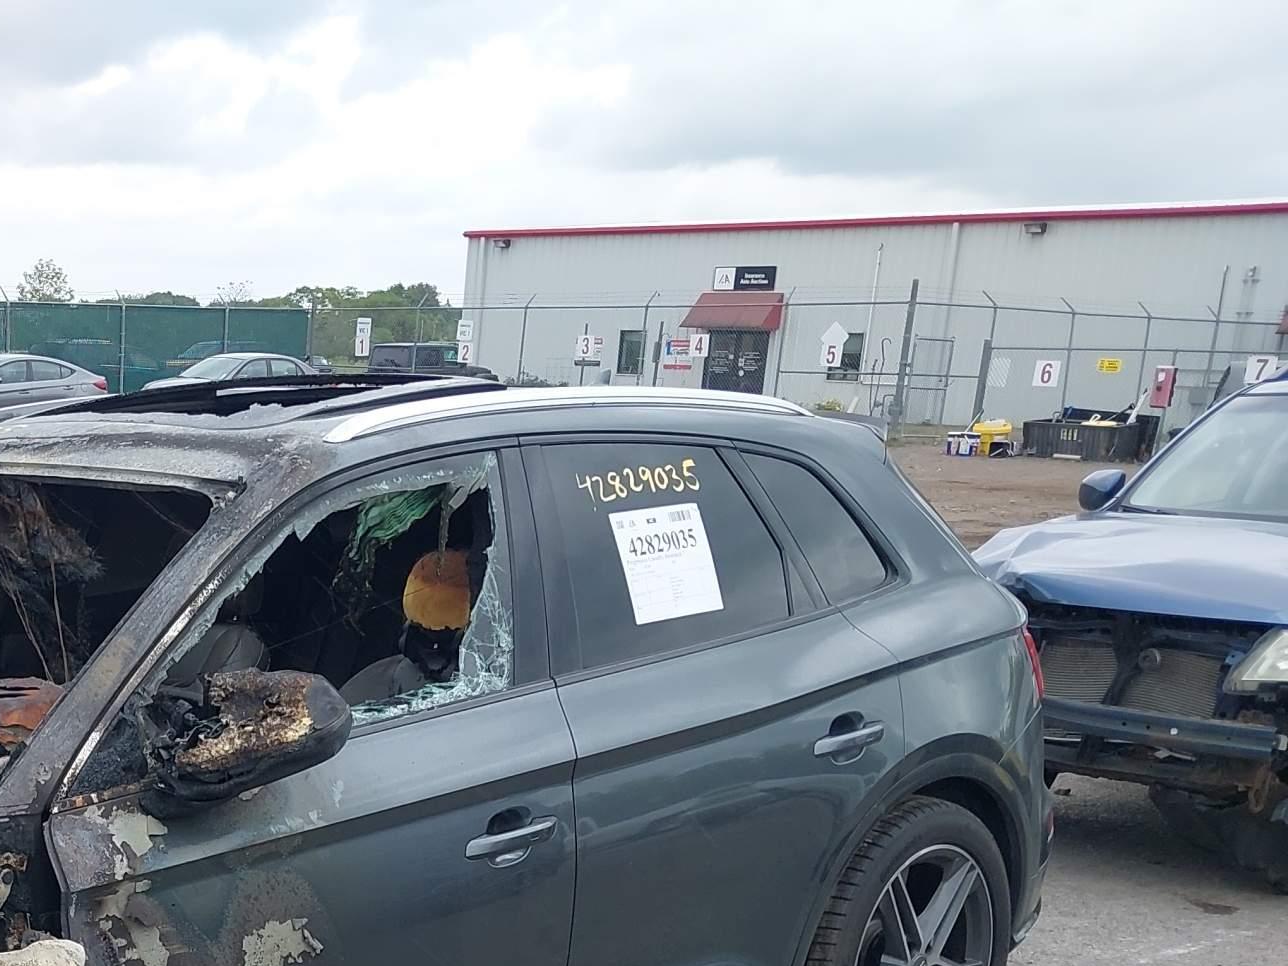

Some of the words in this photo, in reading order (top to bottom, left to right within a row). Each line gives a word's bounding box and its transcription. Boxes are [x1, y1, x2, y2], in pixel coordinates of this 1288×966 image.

[359, 339, 364, 354] 1
[462, 345, 470, 361] 2
[581, 337, 590, 354] 3
[694, 336, 704, 355] 4
[826, 345, 837, 364] 5
[1040, 362, 1053, 384] 6
[1255, 358, 1269, 381] 7
[575, 459, 700, 503] 42829035
[628, 528, 697, 557] 42829035
